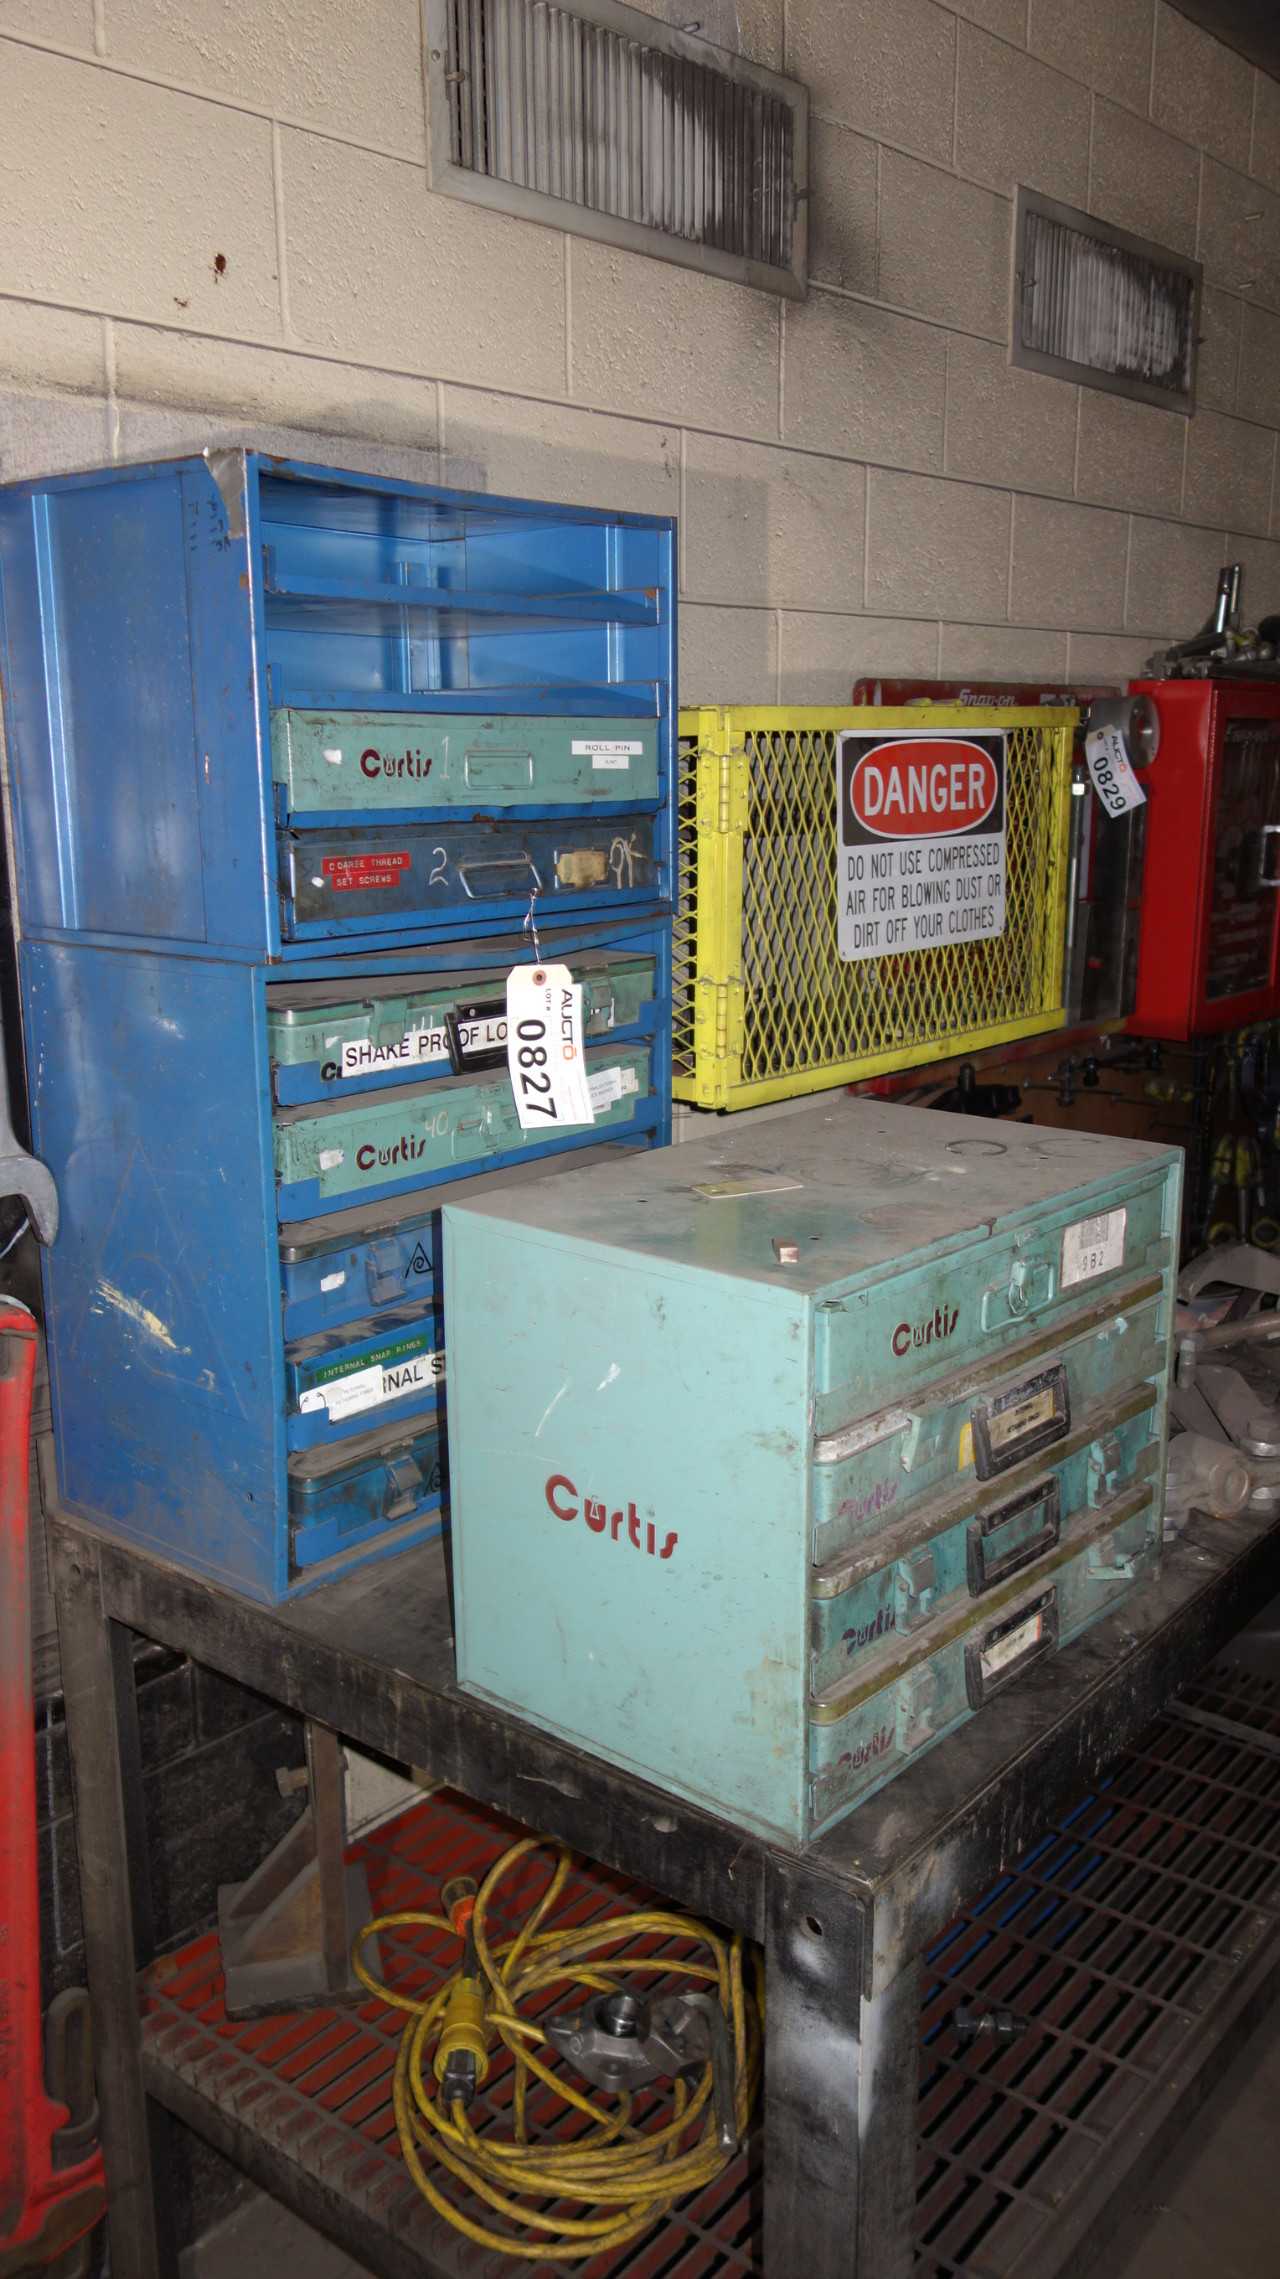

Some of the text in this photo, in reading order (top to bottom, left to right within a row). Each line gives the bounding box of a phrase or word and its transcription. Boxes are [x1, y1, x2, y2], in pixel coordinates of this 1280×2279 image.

[360, 748, 433, 778] Curtis
[585, 744, 631, 752] ROLL PIN
[864, 763, 986, 817] DANGER
[1094, 757, 1126, 810] 0829
[336, 874, 392, 887] SET SCREWS
[371, 856, 403, 866] THREAD
[429, 847, 449, 886] 2
[847, 842, 1000, 881] DO NOT USE COMPRESSED
[846, 873, 1001, 916] AIR FOR BLOWING DUST OR
[854, 905, 994, 949] DIRT OFF YOUR CLOTHES
[345, 1037, 410, 1068] SHAKE
[516, 1019, 558, 1119] 0827
[356, 1134, 426, 1171] Curtis
[892, 1304, 959, 1357] Curtis
[323, 1359, 366, 1379] INTERNAL
[545, 1473, 679, 1560] Curtis
